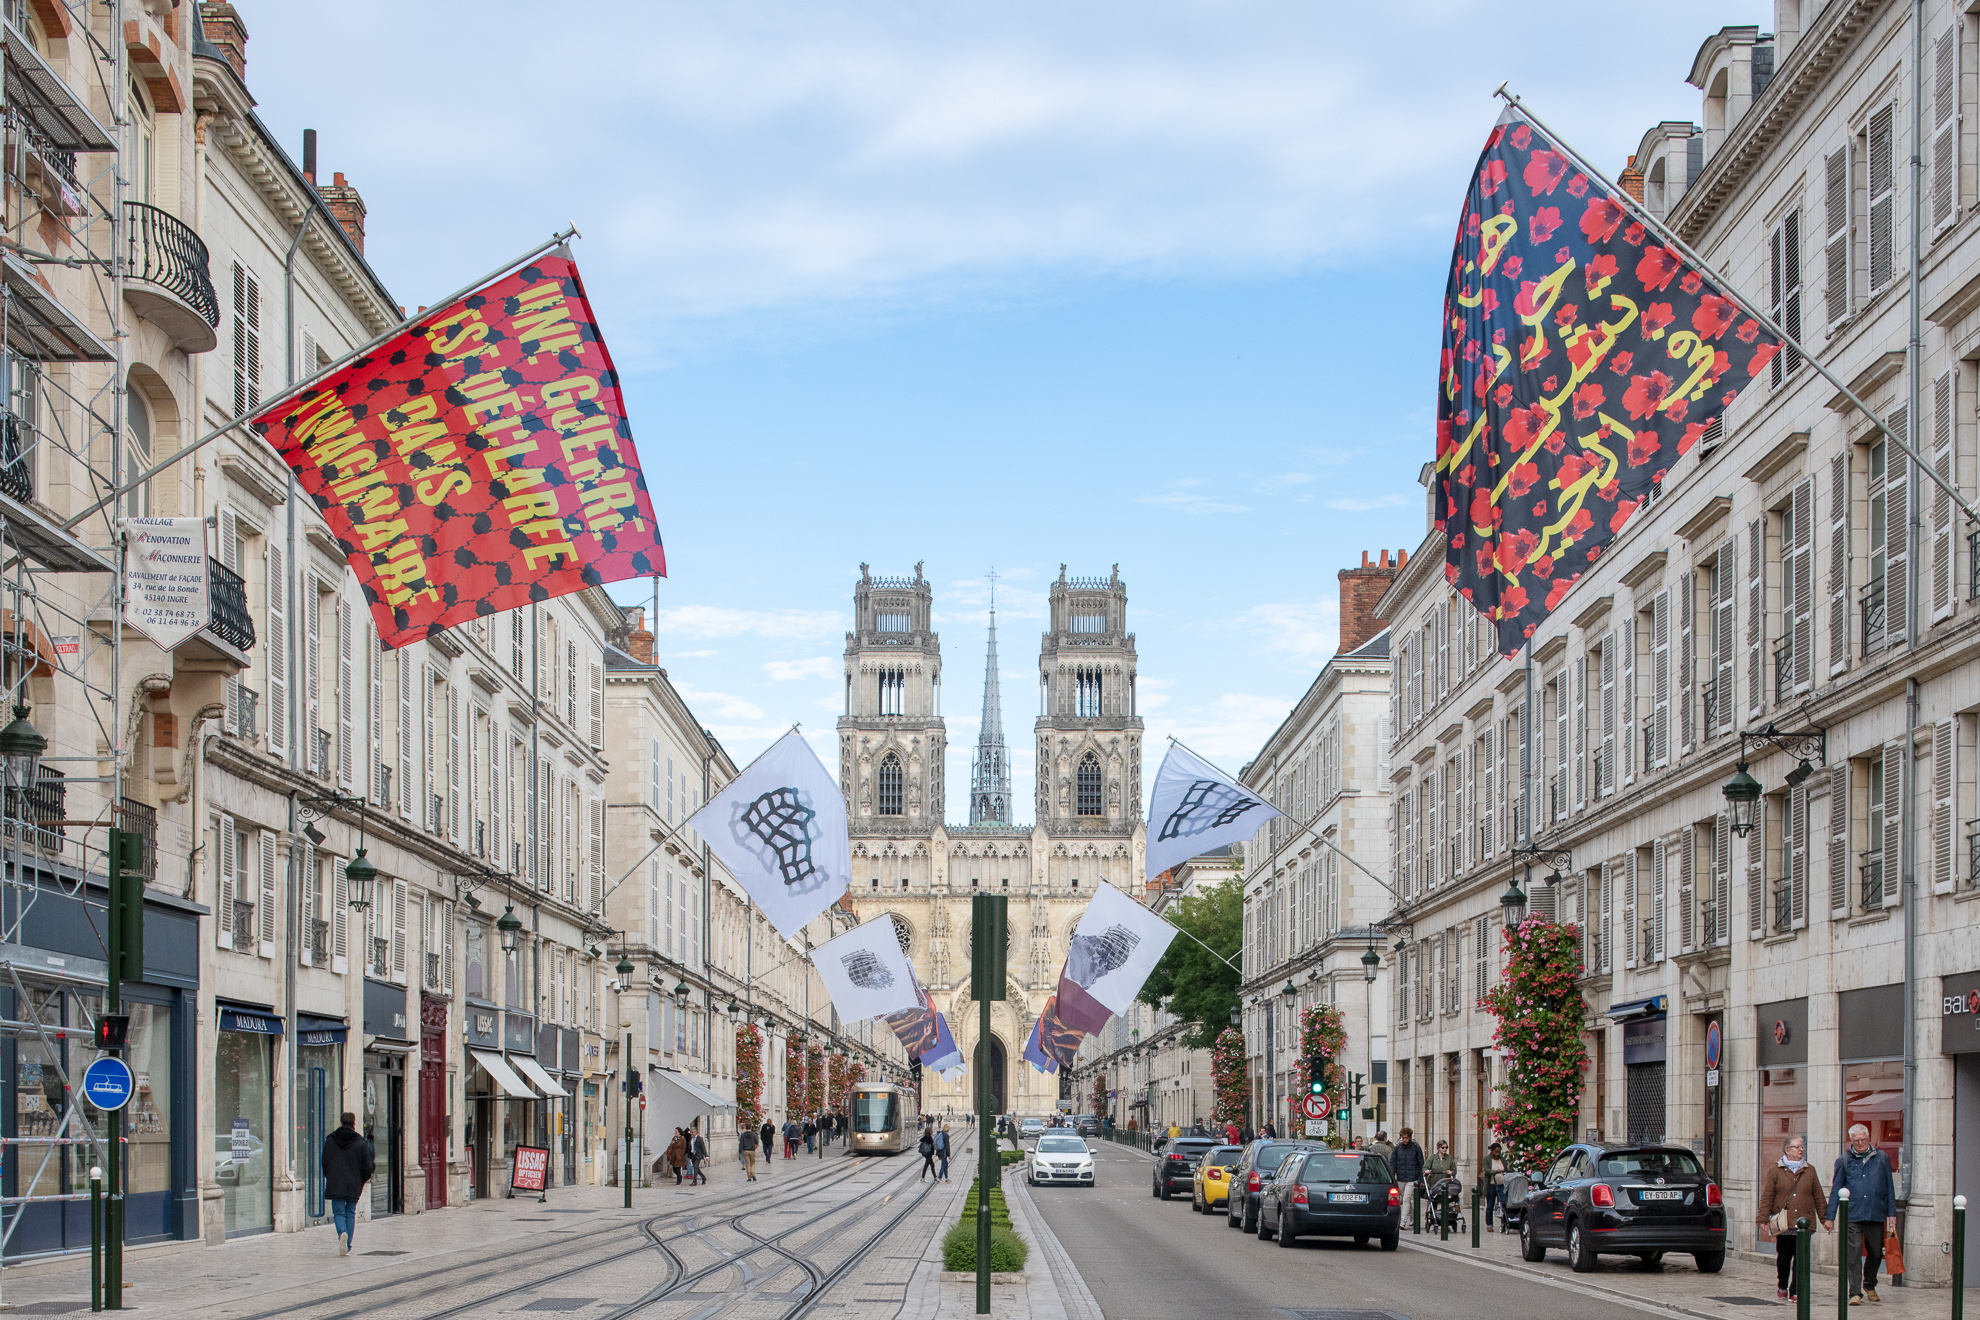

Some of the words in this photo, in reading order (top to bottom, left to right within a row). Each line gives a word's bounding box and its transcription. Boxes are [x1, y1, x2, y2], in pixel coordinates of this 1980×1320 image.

[511, 281, 586, 365] UNE
[379, 394, 473, 507] DANS
[540, 375, 646, 542] GUERRE
[453, 367, 578, 572] DÉCLARÉE
[132, 531, 191, 545] RÉNOVATION
[141, 549, 202, 564] MAÇONNERIE
[128, 571, 167, 581] RAVALEMENT
[168, 574, 178, 582] de
[178, 575, 202, 583] FAÇADE
[132, 582, 144, 591] 34,
[177, 585, 199, 593] Bonde
[144, 593, 166, 602] 45140
[166, 595, 189, 603] INGRÉ
[142, 608, 152, 616] 02
[175, 610, 185, 618] 68
[186, 611, 195, 619] 75
[146, 617, 156, 625] 06
[190, 619, 200, 627] 38
[236, 1015, 268, 1031] MADURA
[307, 1031, 334, 1043] MADURA
[517, 1150, 546, 1171] LISSAC
[518, 1168, 542, 1179] OPTICIEN
